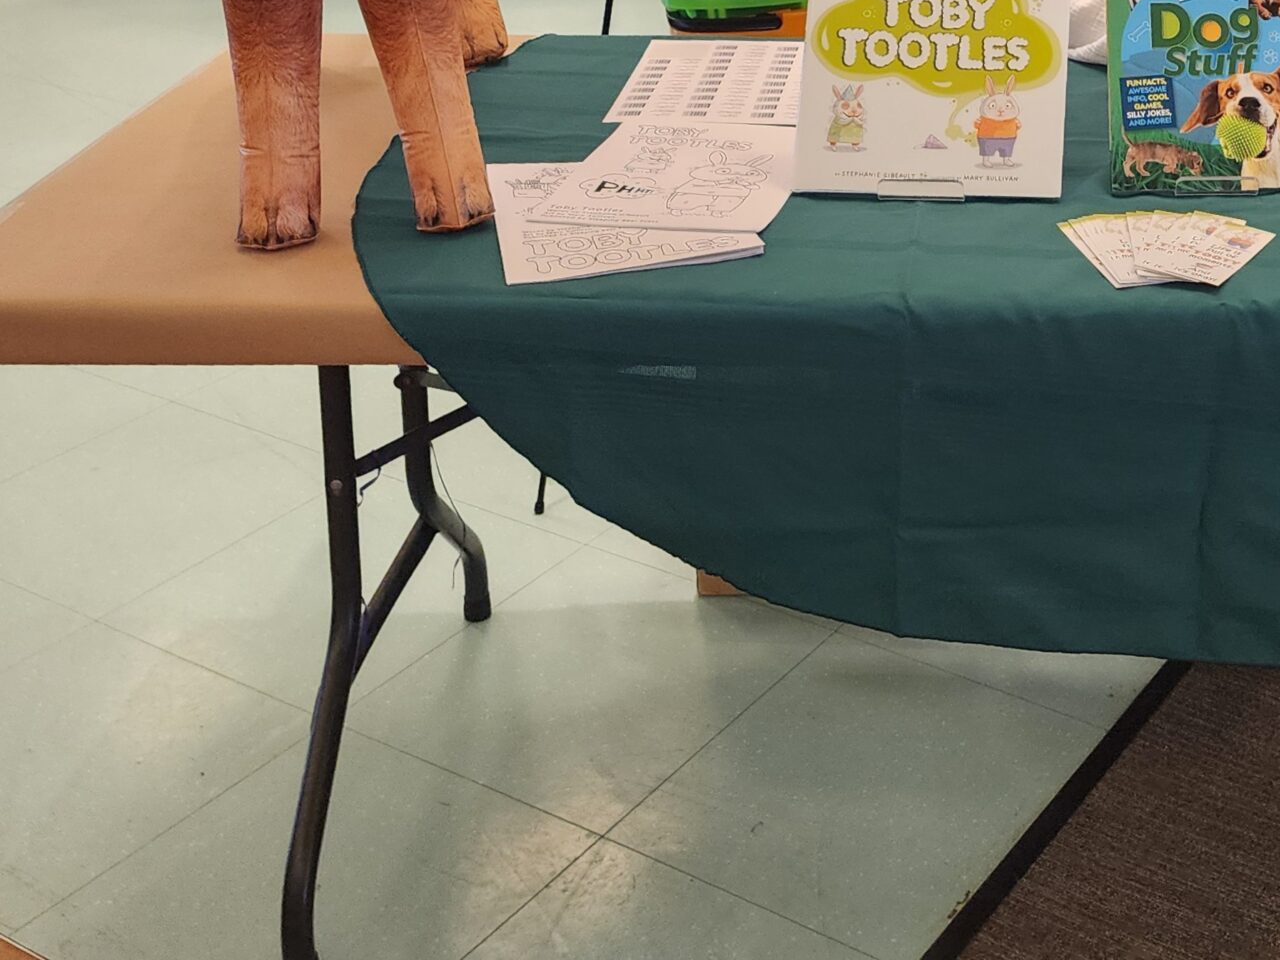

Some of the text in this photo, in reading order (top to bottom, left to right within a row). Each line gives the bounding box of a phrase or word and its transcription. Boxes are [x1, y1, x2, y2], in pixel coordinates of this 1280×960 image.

[1150, 2, 1259, 49] Dog
[837, 27, 1030, 71] TOOTLES
[1164, 43, 1258, 77] Stuff
[1143, 78, 1167, 86] FACTS,
[1128, 86, 1167, 95] AWESOME
[1127, 93, 1169, 103] INFO, COOL
[1134, 102, 1163, 110] GAMES,
[1127, 109, 1172, 119] SILLY JOKES,
[1147, 117, 1172, 125] MORE!
[639, 125, 709, 137] TOBY
[630, 136, 752, 151] TOOTLES
[522, 228, 648, 255] TOBY
[526, 236, 739, 273] TOOTLES
